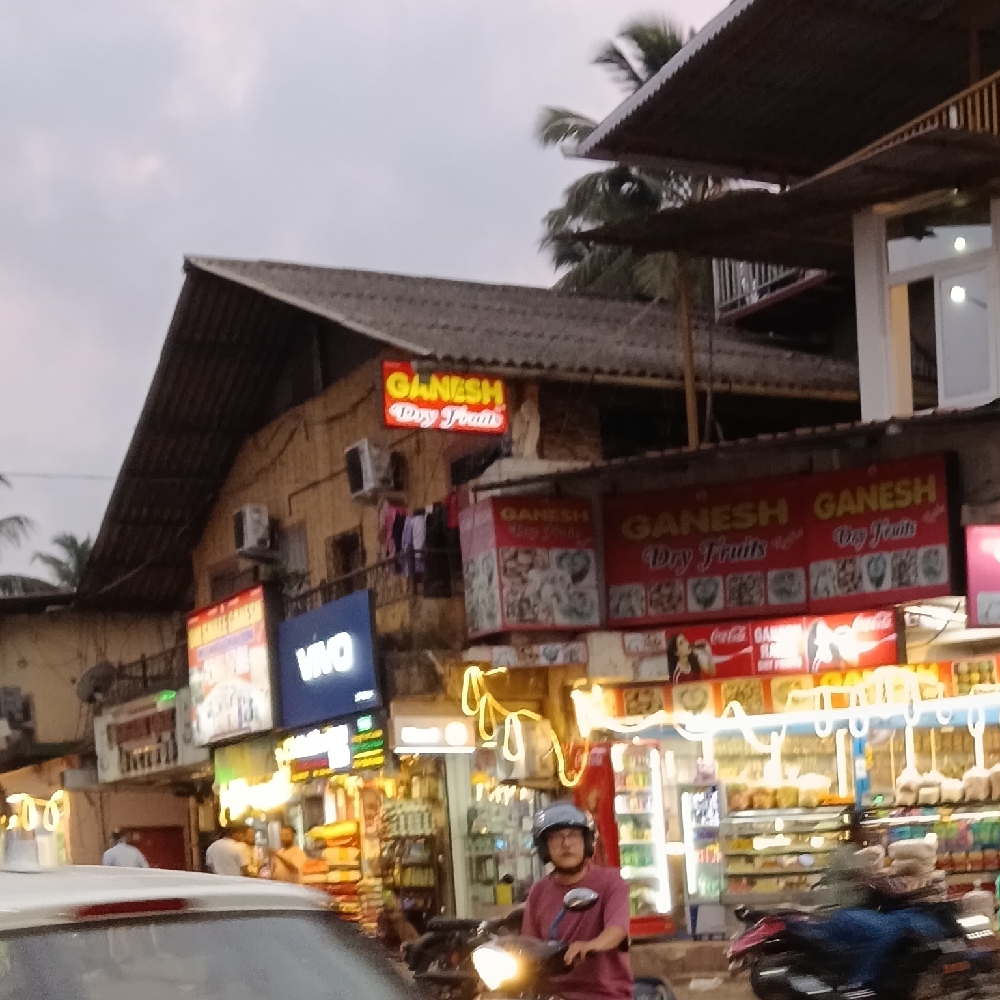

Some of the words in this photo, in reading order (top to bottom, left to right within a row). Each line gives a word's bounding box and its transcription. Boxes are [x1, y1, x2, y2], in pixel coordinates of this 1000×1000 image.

[386, 371, 504, 405] GANESH
[389, 402, 440, 428] Dry
[500, 506, 590, 521] GANESH
[812, 474, 937, 521] GANESH
[621, 499, 788, 541] GANESH
[833, 525, 868, 550] Dry
[868, 517, 917, 548] Fruits
[642, 543, 693, 575] Dry
[697, 534, 767, 573] Fruits
